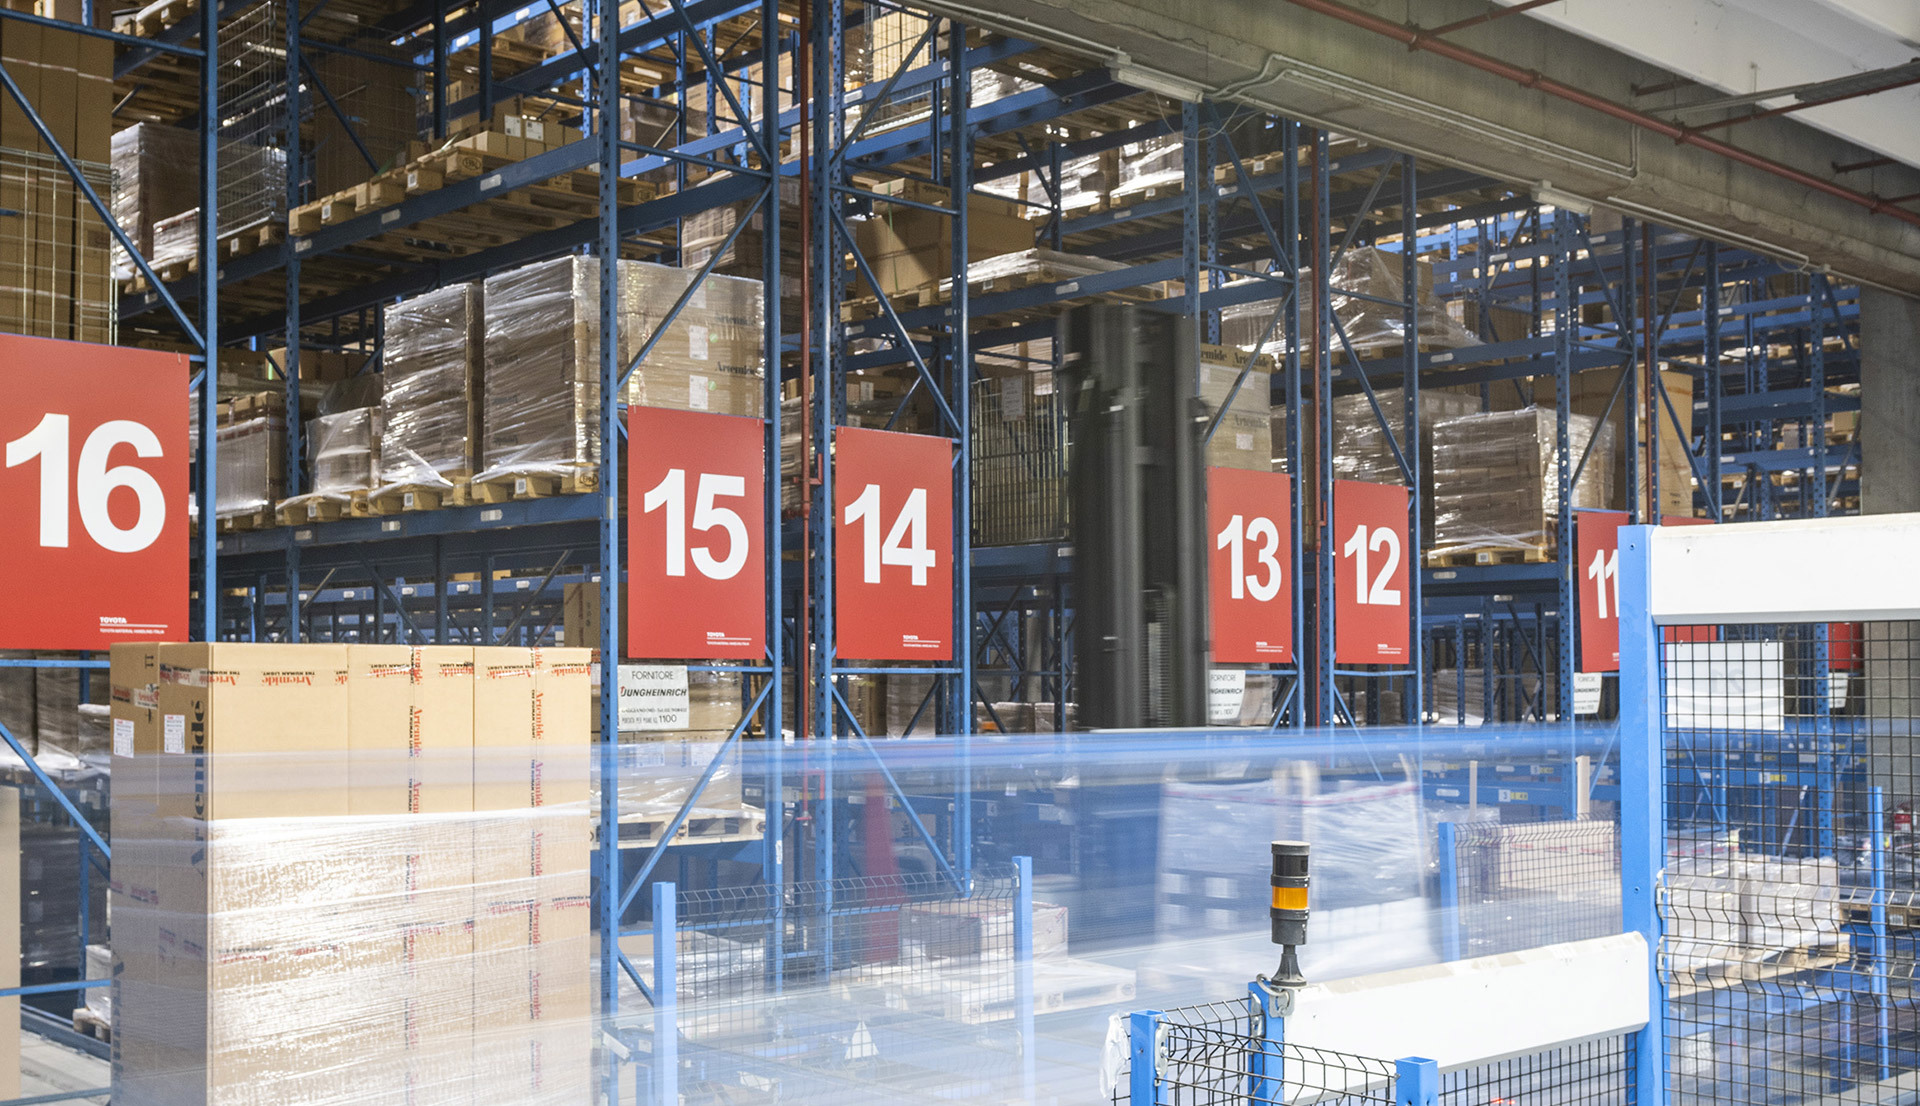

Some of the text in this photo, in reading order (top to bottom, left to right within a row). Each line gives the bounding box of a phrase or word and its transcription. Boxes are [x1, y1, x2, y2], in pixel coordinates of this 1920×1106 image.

[6, 413, 166, 554] 16
[643, 468, 750, 581] 15
[844, 484, 937, 586] 14
[1217, 514, 1282, 602] 13
[1343, 524, 1401, 606] 12
[1588, 549, 1619, 619] 11
[100, 616, 127, 624] TOYOTA
[262, 675, 315, 686] Artemide
[620, 687, 688, 697] JUNGHEINRICH
[631, 670, 674, 680] FORNITORE
[414, 708, 422, 758] Artemide
[659, 714, 677, 723] 1100
